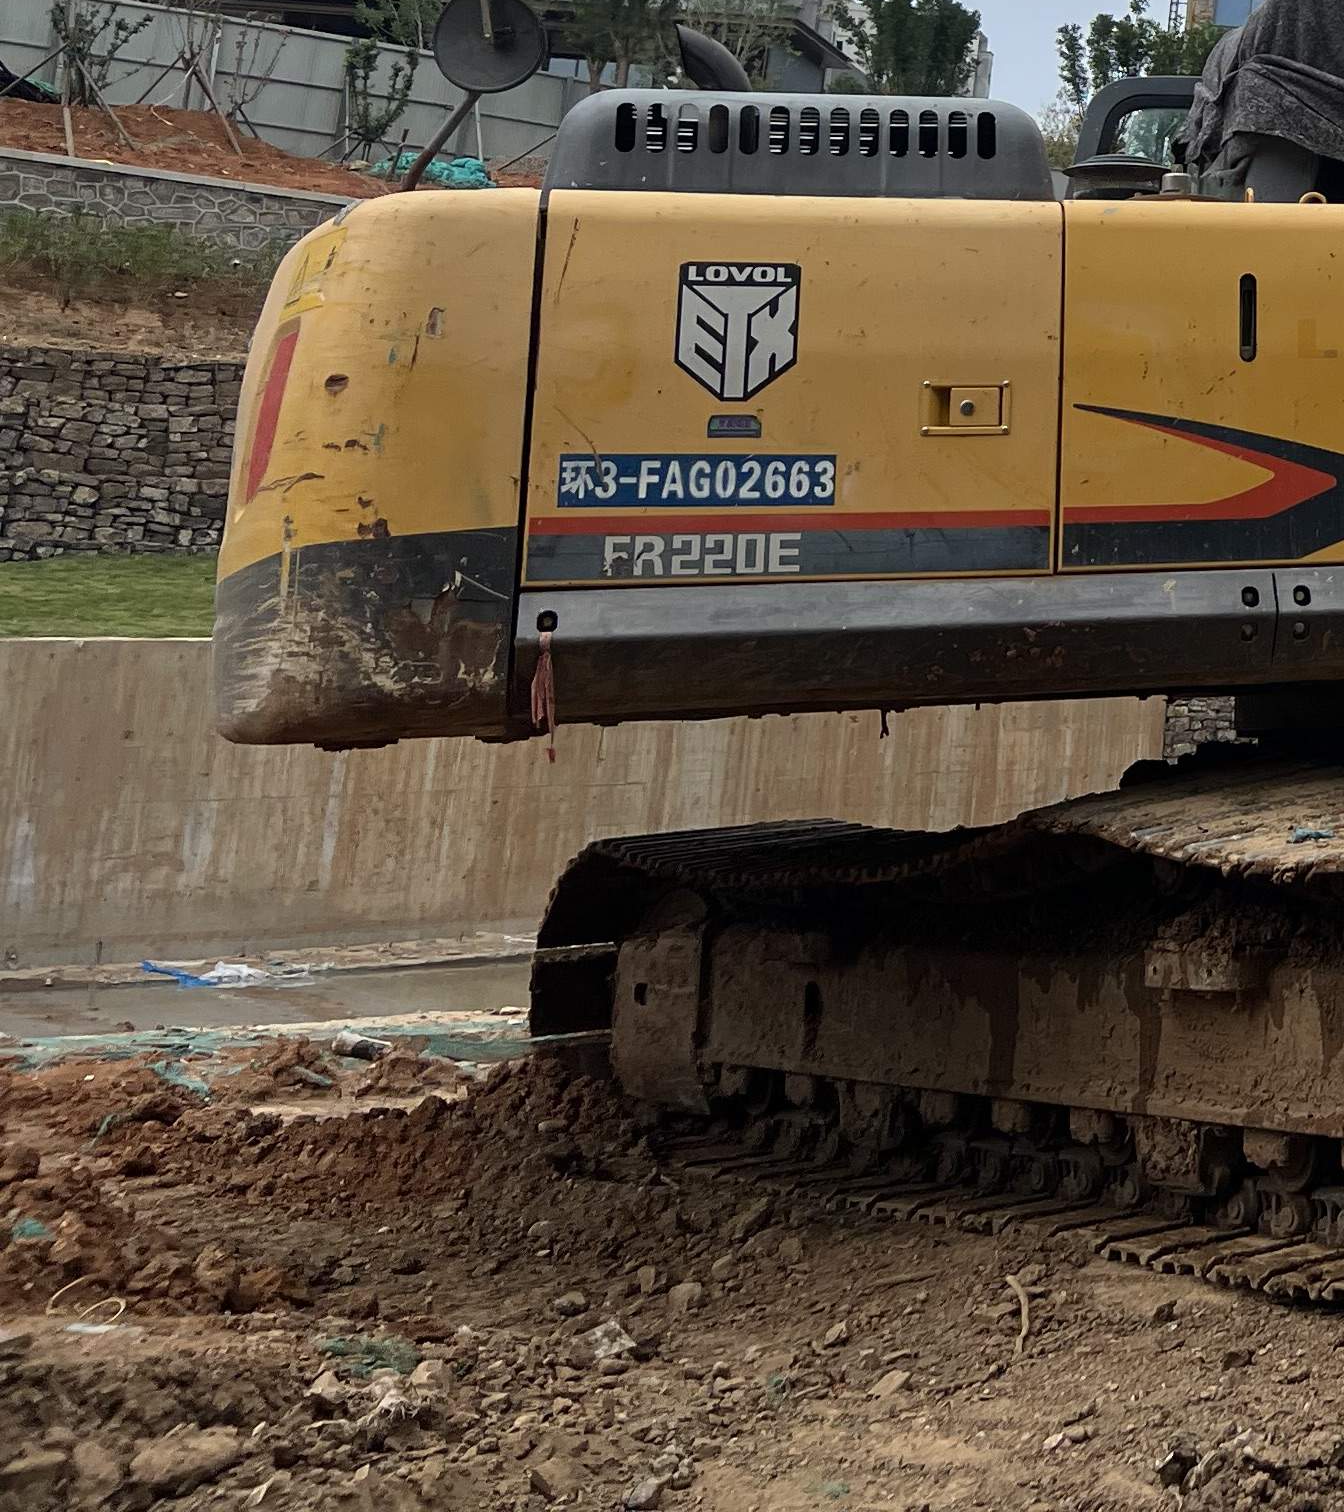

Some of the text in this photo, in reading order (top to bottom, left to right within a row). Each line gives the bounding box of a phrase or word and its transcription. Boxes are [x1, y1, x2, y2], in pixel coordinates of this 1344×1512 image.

[687, 266, 792, 283] LOVOL
[561, 460, 835, 500] 环3-FAG02663
[603, 533, 801, 577] FR220E
